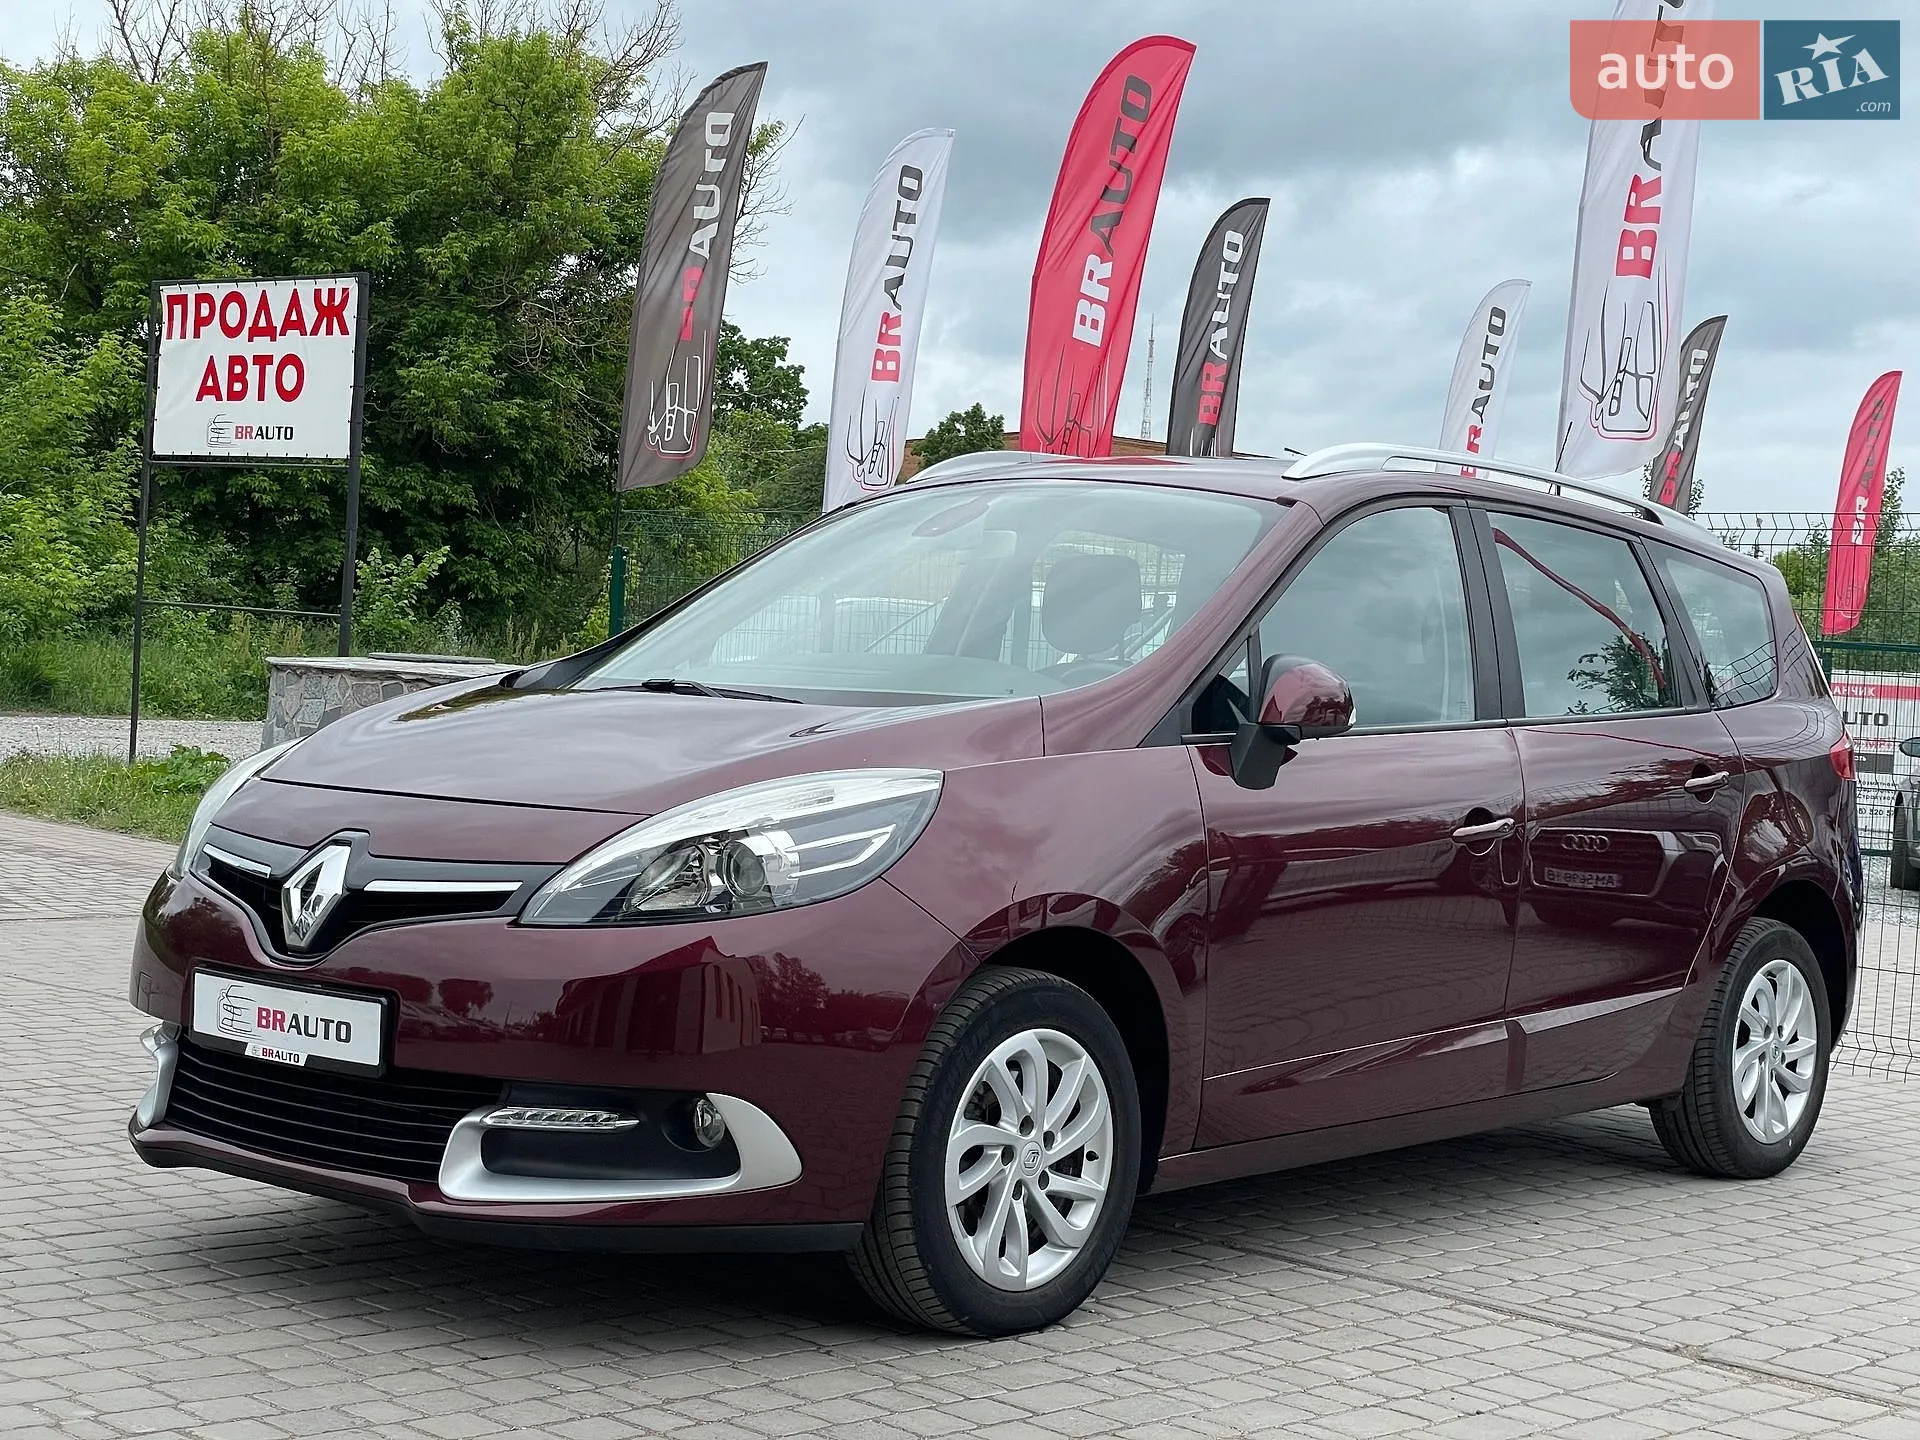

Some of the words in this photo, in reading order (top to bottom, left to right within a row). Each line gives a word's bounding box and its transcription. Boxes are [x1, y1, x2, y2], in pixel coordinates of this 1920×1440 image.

[1072, 74, 1153, 348] BRAUTO
[872, 165, 923, 382] BRAUTO
[165, 287, 350, 342] ПРОДАЖ
[1198, 230, 1244, 426] BRAUTO
[195, 353, 305, 402] АВТО
[234, 425, 294, 441] BRAUTO
[256, 1006, 352, 1044] BRAUTO
[261, 1047, 300, 1064] BRAUTO
